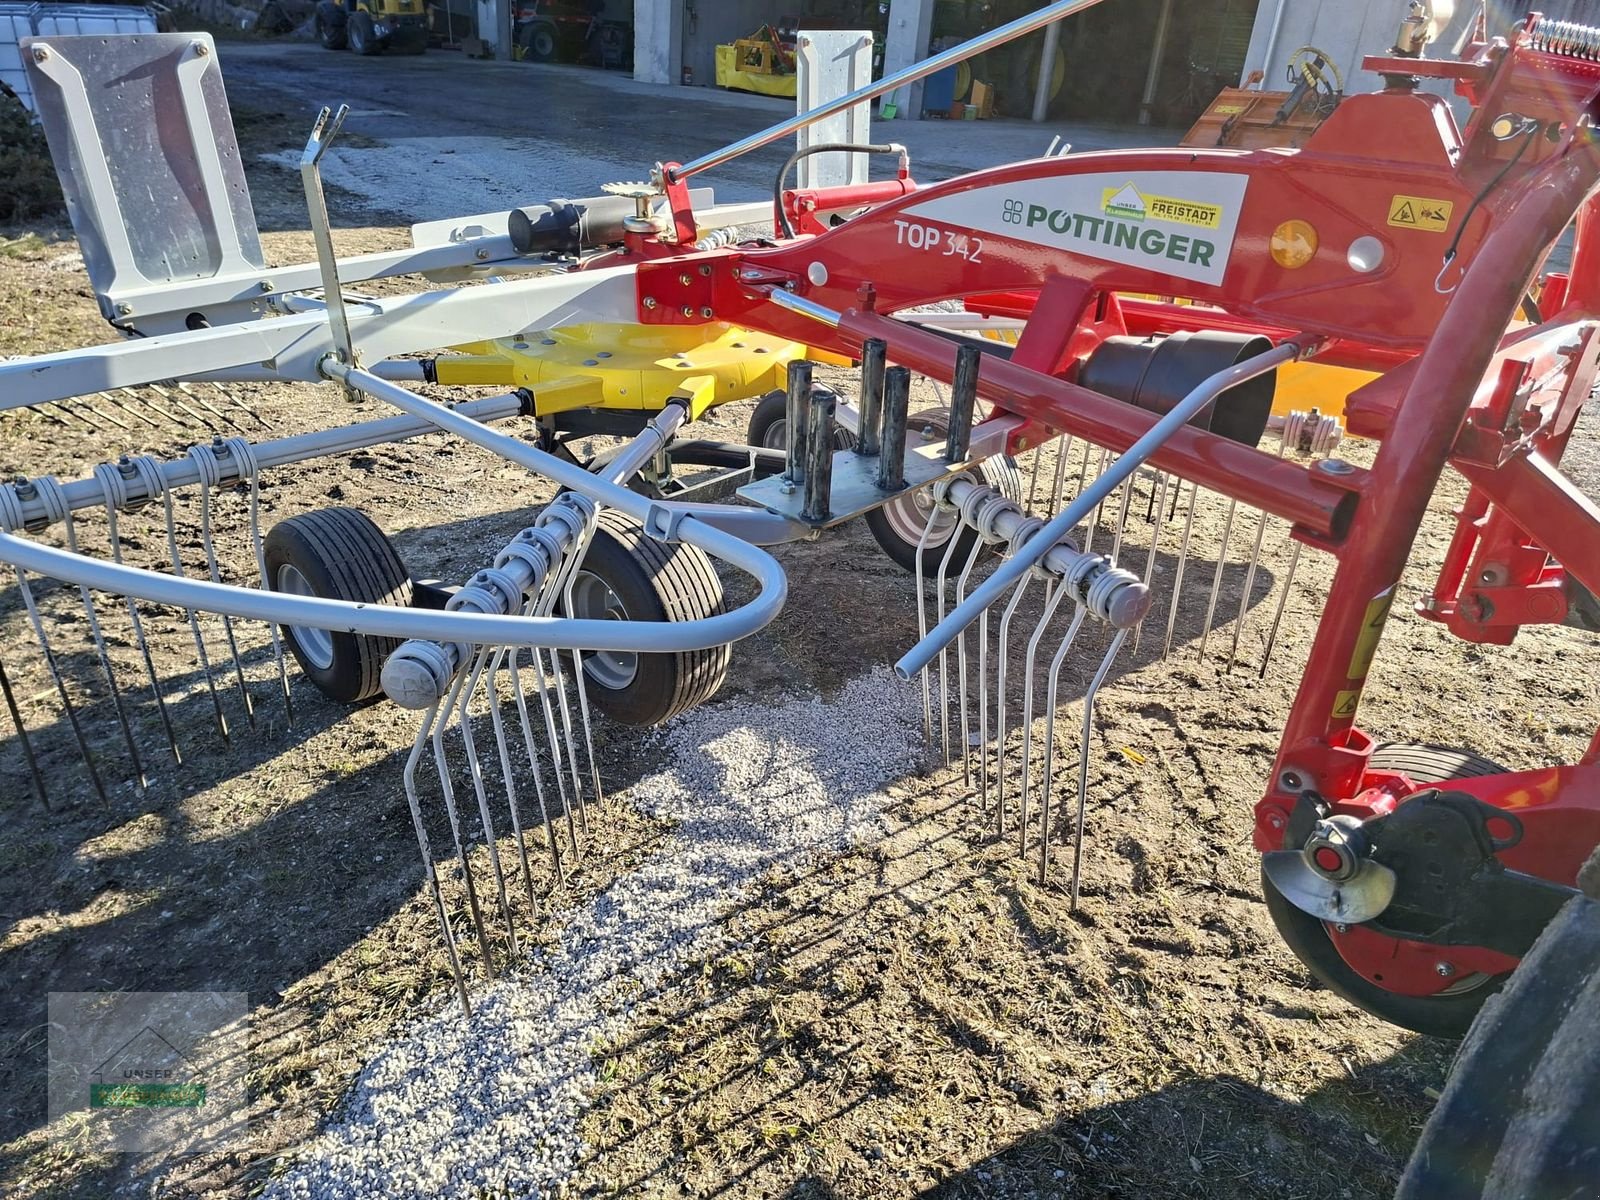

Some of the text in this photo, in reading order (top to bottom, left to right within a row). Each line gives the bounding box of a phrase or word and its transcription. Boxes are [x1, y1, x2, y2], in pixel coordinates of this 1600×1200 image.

[1152, 203, 1216, 222] FREISTADT
[894, 219, 984, 264] TOP 342
[1026, 204, 1216, 268] PÖTTINGER
